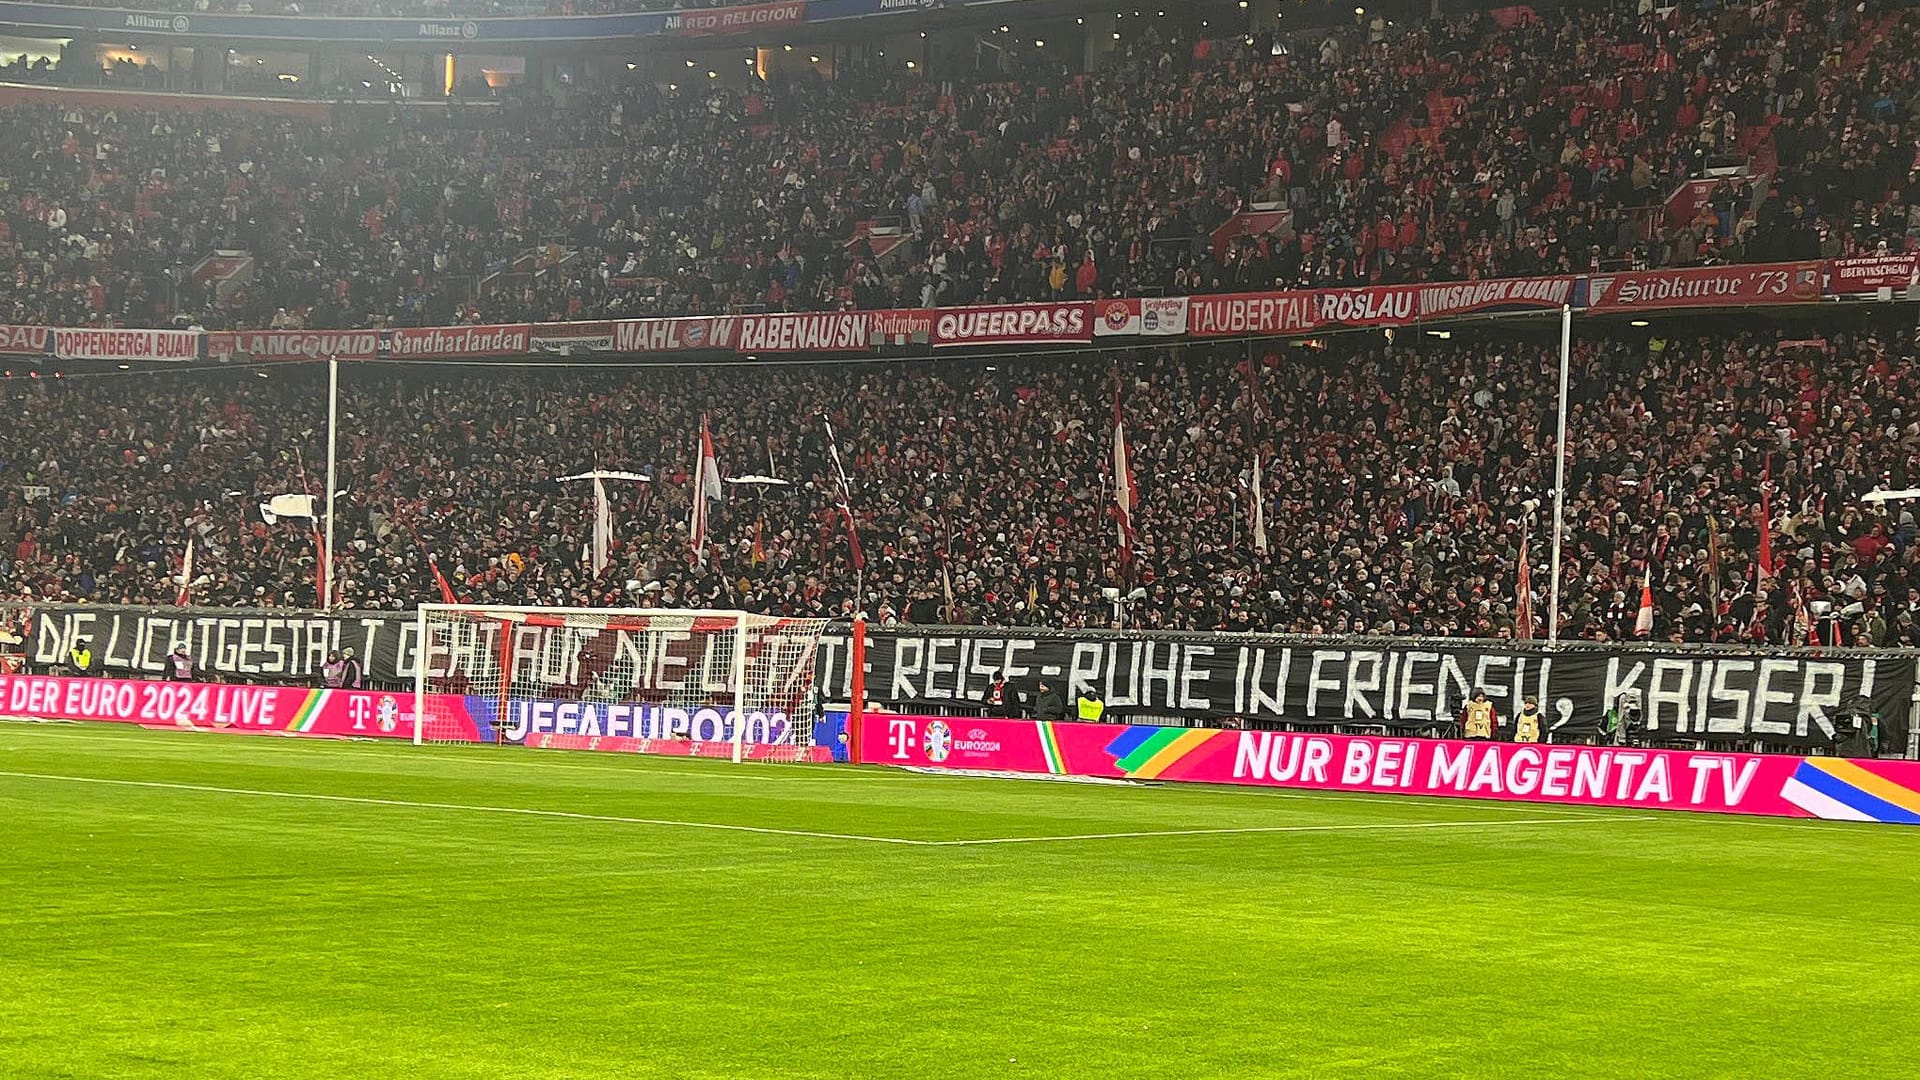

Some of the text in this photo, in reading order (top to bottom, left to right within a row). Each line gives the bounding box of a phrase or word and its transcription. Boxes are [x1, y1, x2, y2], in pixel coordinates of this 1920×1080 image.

[125, 14, 169, 29] Allianz
[419, 23, 460, 36] Allianz
[686, 7, 798, 29] RED RELIGION
[1509, 280, 1570, 304] BUAM
[1618, 270, 1789, 304] Südkurve '73
[1192, 298, 1314, 331] TAUBERTAL
[1321, 292, 1412, 321] RÖSLAU
[740, 315, 868, 349] RABENAU/SN
[937, 308, 1084, 339] QUEERPASS
[56, 331, 196, 358] POPPENBERGA BUAM
[36, 613, 97, 665] DIE
[1234, 646, 1292, 716] IN
[11, 679, 61, 713] DER
[65, 682, 136, 718] EURO
[141, 685, 208, 721] 2024
[214, 688, 279, 726] LIVE
[1232, 730, 1762, 807] NUR BEI MAGENTA TV
